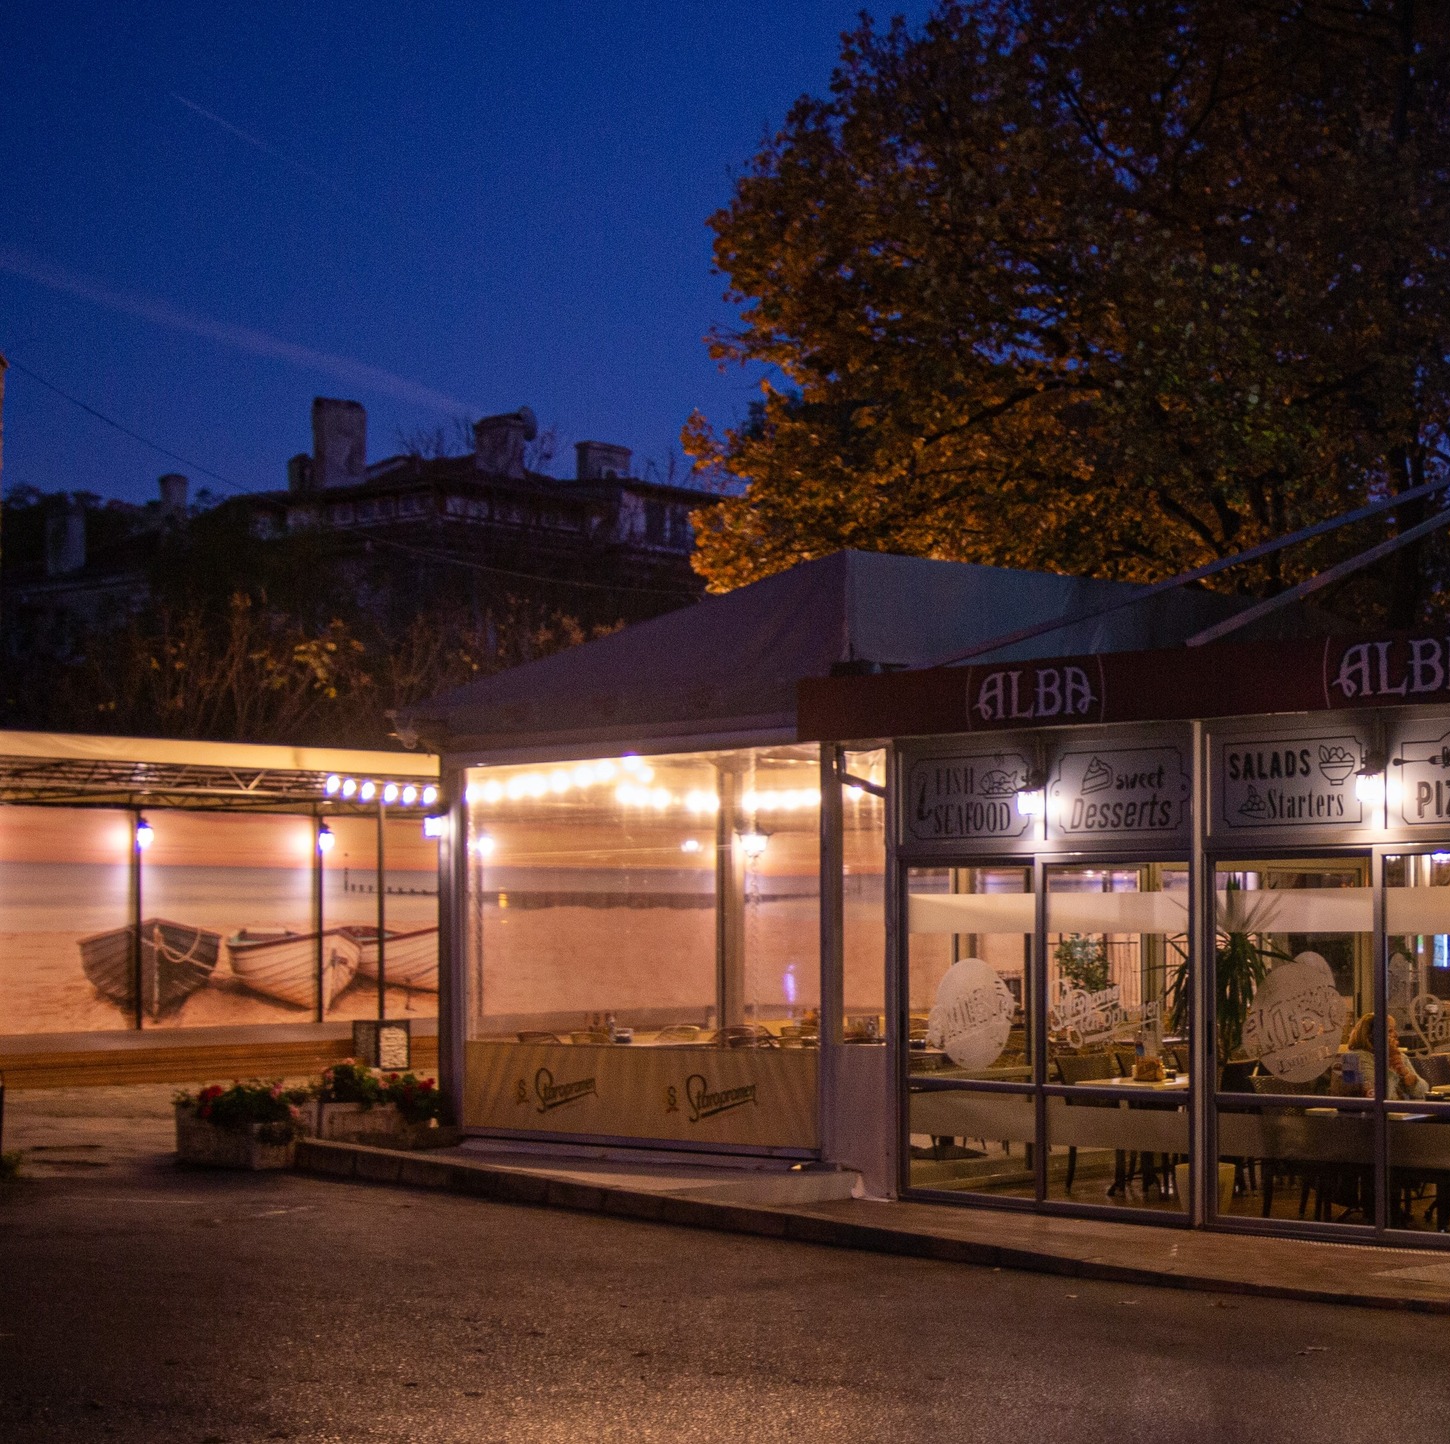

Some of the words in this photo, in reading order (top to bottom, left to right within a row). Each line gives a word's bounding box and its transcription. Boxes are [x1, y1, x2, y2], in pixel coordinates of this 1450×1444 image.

[972, 666, 1099, 720] ALBA
[1229, 749, 1311, 780] SALADS
[934, 766, 975, 797] FISH
[933, 801, 1012, 835] SEAFOOD
[1070, 798, 1172, 829] Desserts
[1266, 787, 1345, 819] Starters
